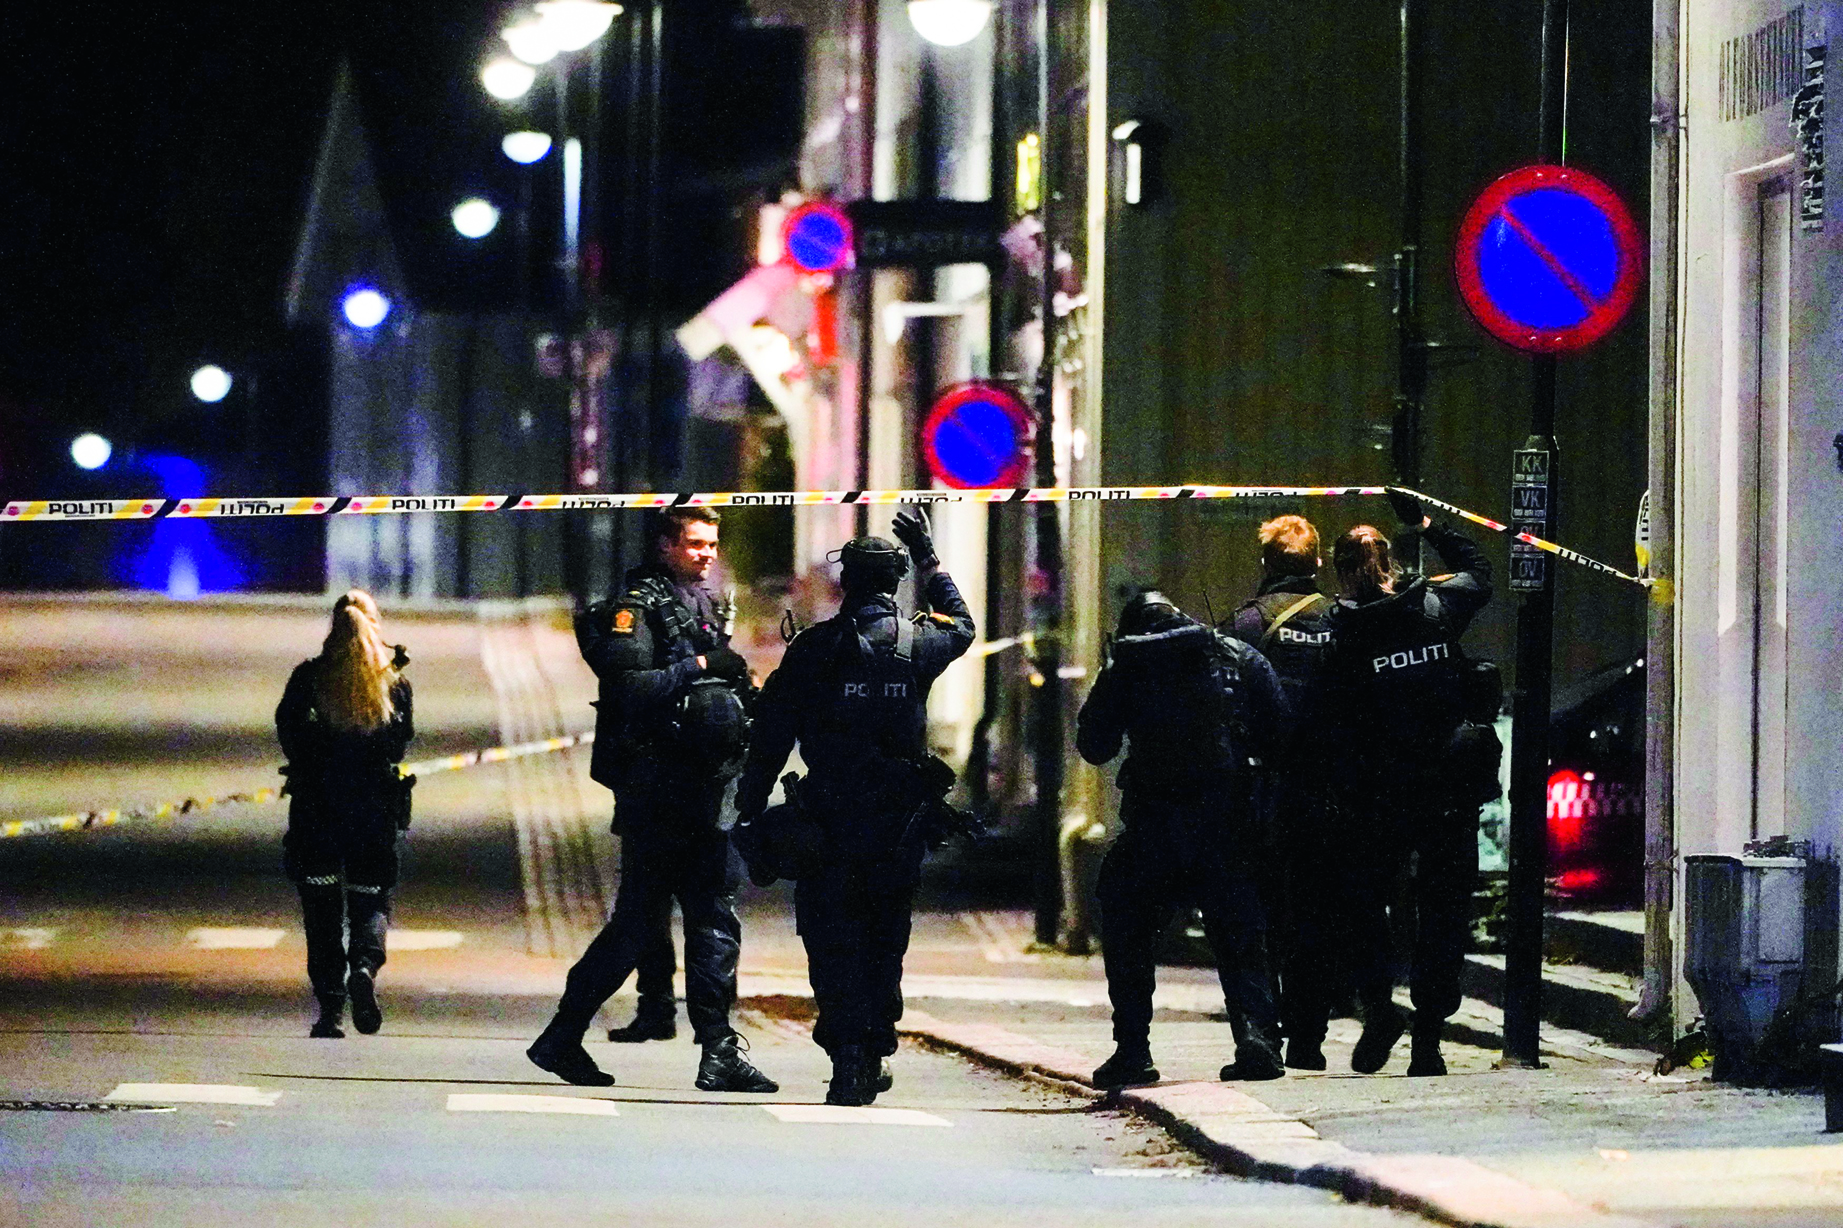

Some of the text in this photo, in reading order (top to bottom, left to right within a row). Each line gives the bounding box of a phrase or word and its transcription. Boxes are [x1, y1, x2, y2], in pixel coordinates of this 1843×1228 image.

[1521, 455, 1543, 473] KK
[392, 498, 456, 510] POLITI
[1520, 490, 1540, 507] VK
[48, 502, 113, 515] POLITI
[220, 503, 285, 516] POLITI
[1279, 628, 1331, 644] POLIT
[1373, 642, 1450, 673] POLITI
[844, 683, 907, 697] POITI
